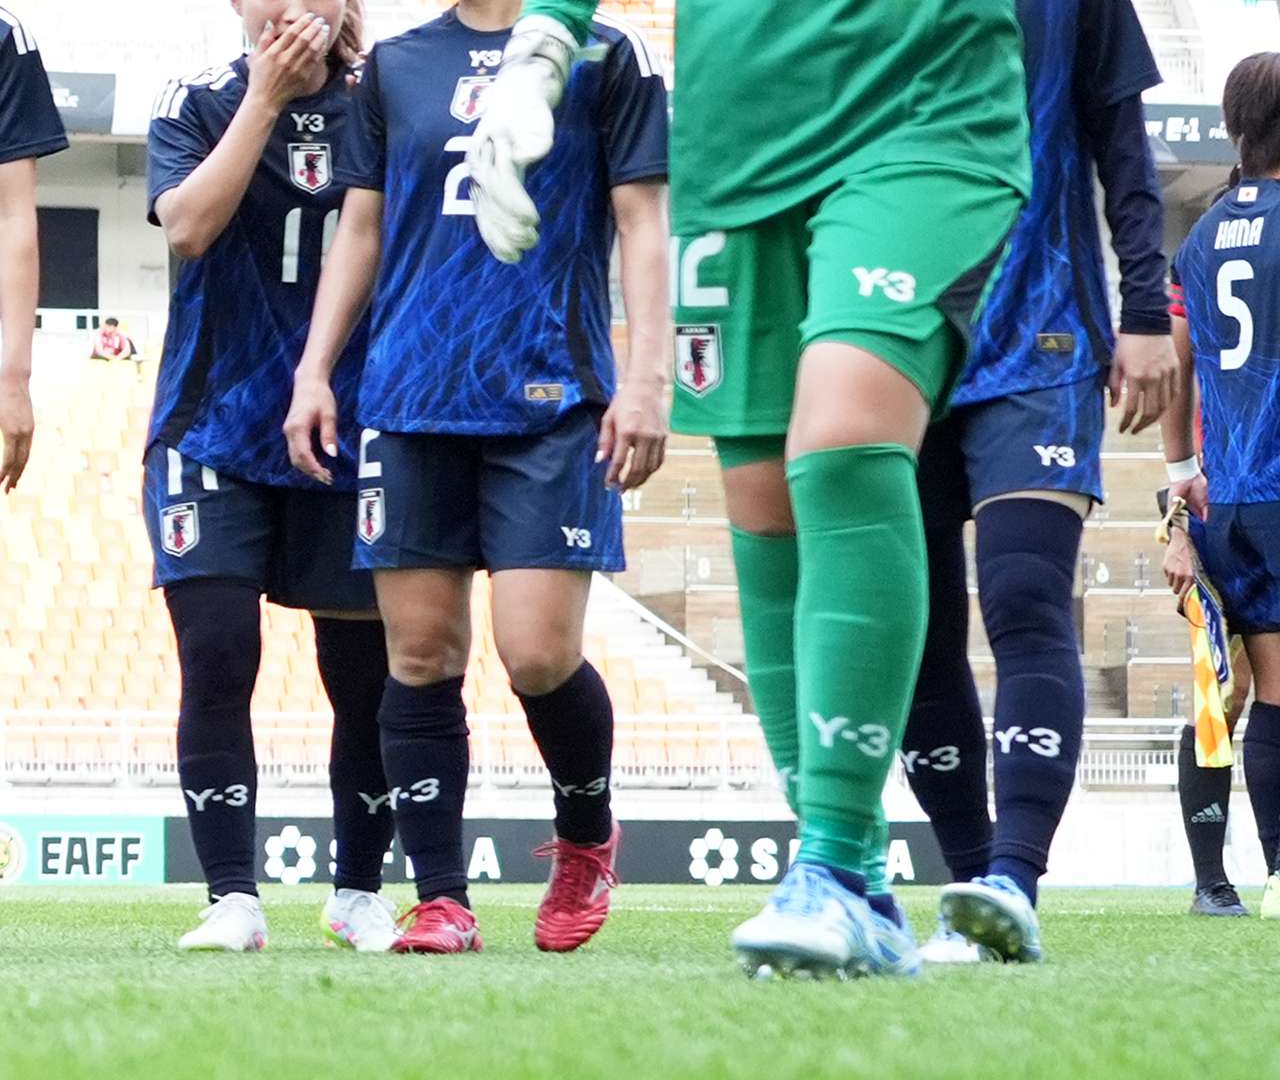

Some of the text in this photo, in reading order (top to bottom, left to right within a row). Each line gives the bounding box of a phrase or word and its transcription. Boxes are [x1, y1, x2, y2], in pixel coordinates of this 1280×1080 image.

[469, 50, 502, 67] Y-3
[291, 113, 325, 132] Y-3
[1214, 217, 1265, 251] HANA
[852, 266, 917, 303] Y-3
[1217, 259, 1254, 370] 5
[1033, 445, 1076, 468] Y-3
[560, 526, 592, 548] Y-3
[809, 712, 890, 758] Y-3
[996, 726, 1062, 758] Y-3
[900, 745, 960, 774] Y-3
[185, 784, 248, 811] Y-3
[41, 837, 140, 875] EAFF
